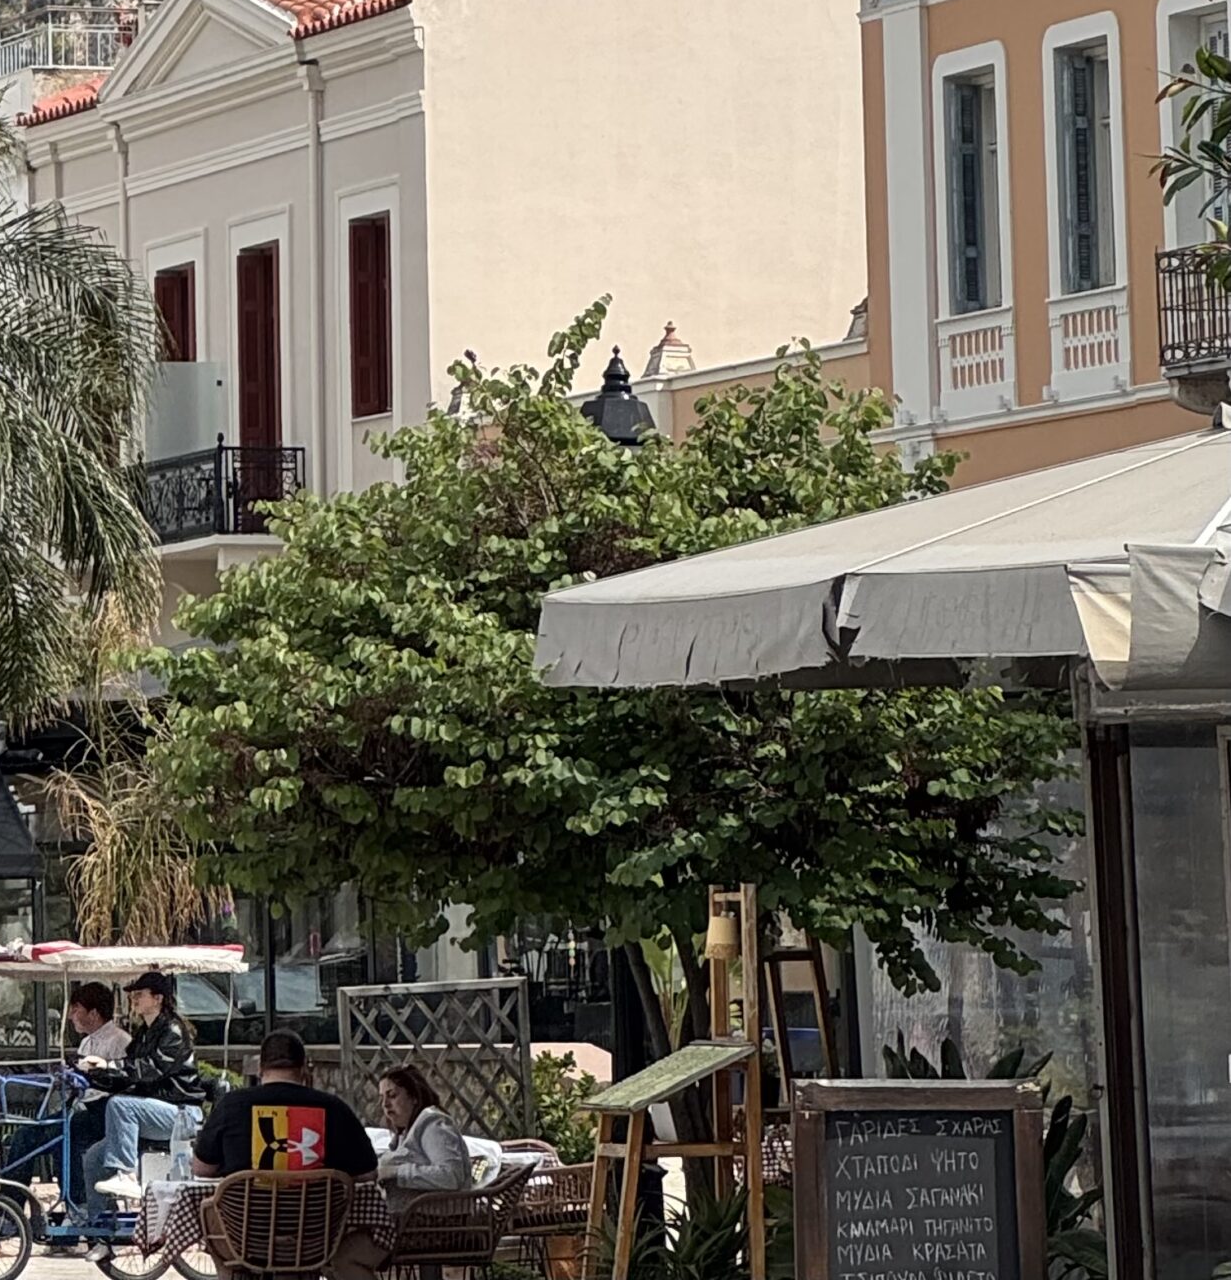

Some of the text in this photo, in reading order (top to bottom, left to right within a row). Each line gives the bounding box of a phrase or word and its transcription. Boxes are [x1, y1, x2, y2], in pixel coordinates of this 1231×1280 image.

[935, 1117, 1003, 1137] ΣΧΑΡΑΣ
[835, 1148, 979, 1180] ΧΤΑΠΟΔΙ ΨΗΤΟ
[836, 1184, 984, 1212] ΜΥΔΙΑ ΣΑΓΑΝΑΚΙ
[837, 1239, 987, 1266] ΜΥΔΙΑ ΚΡΑΣΑΤΑ
